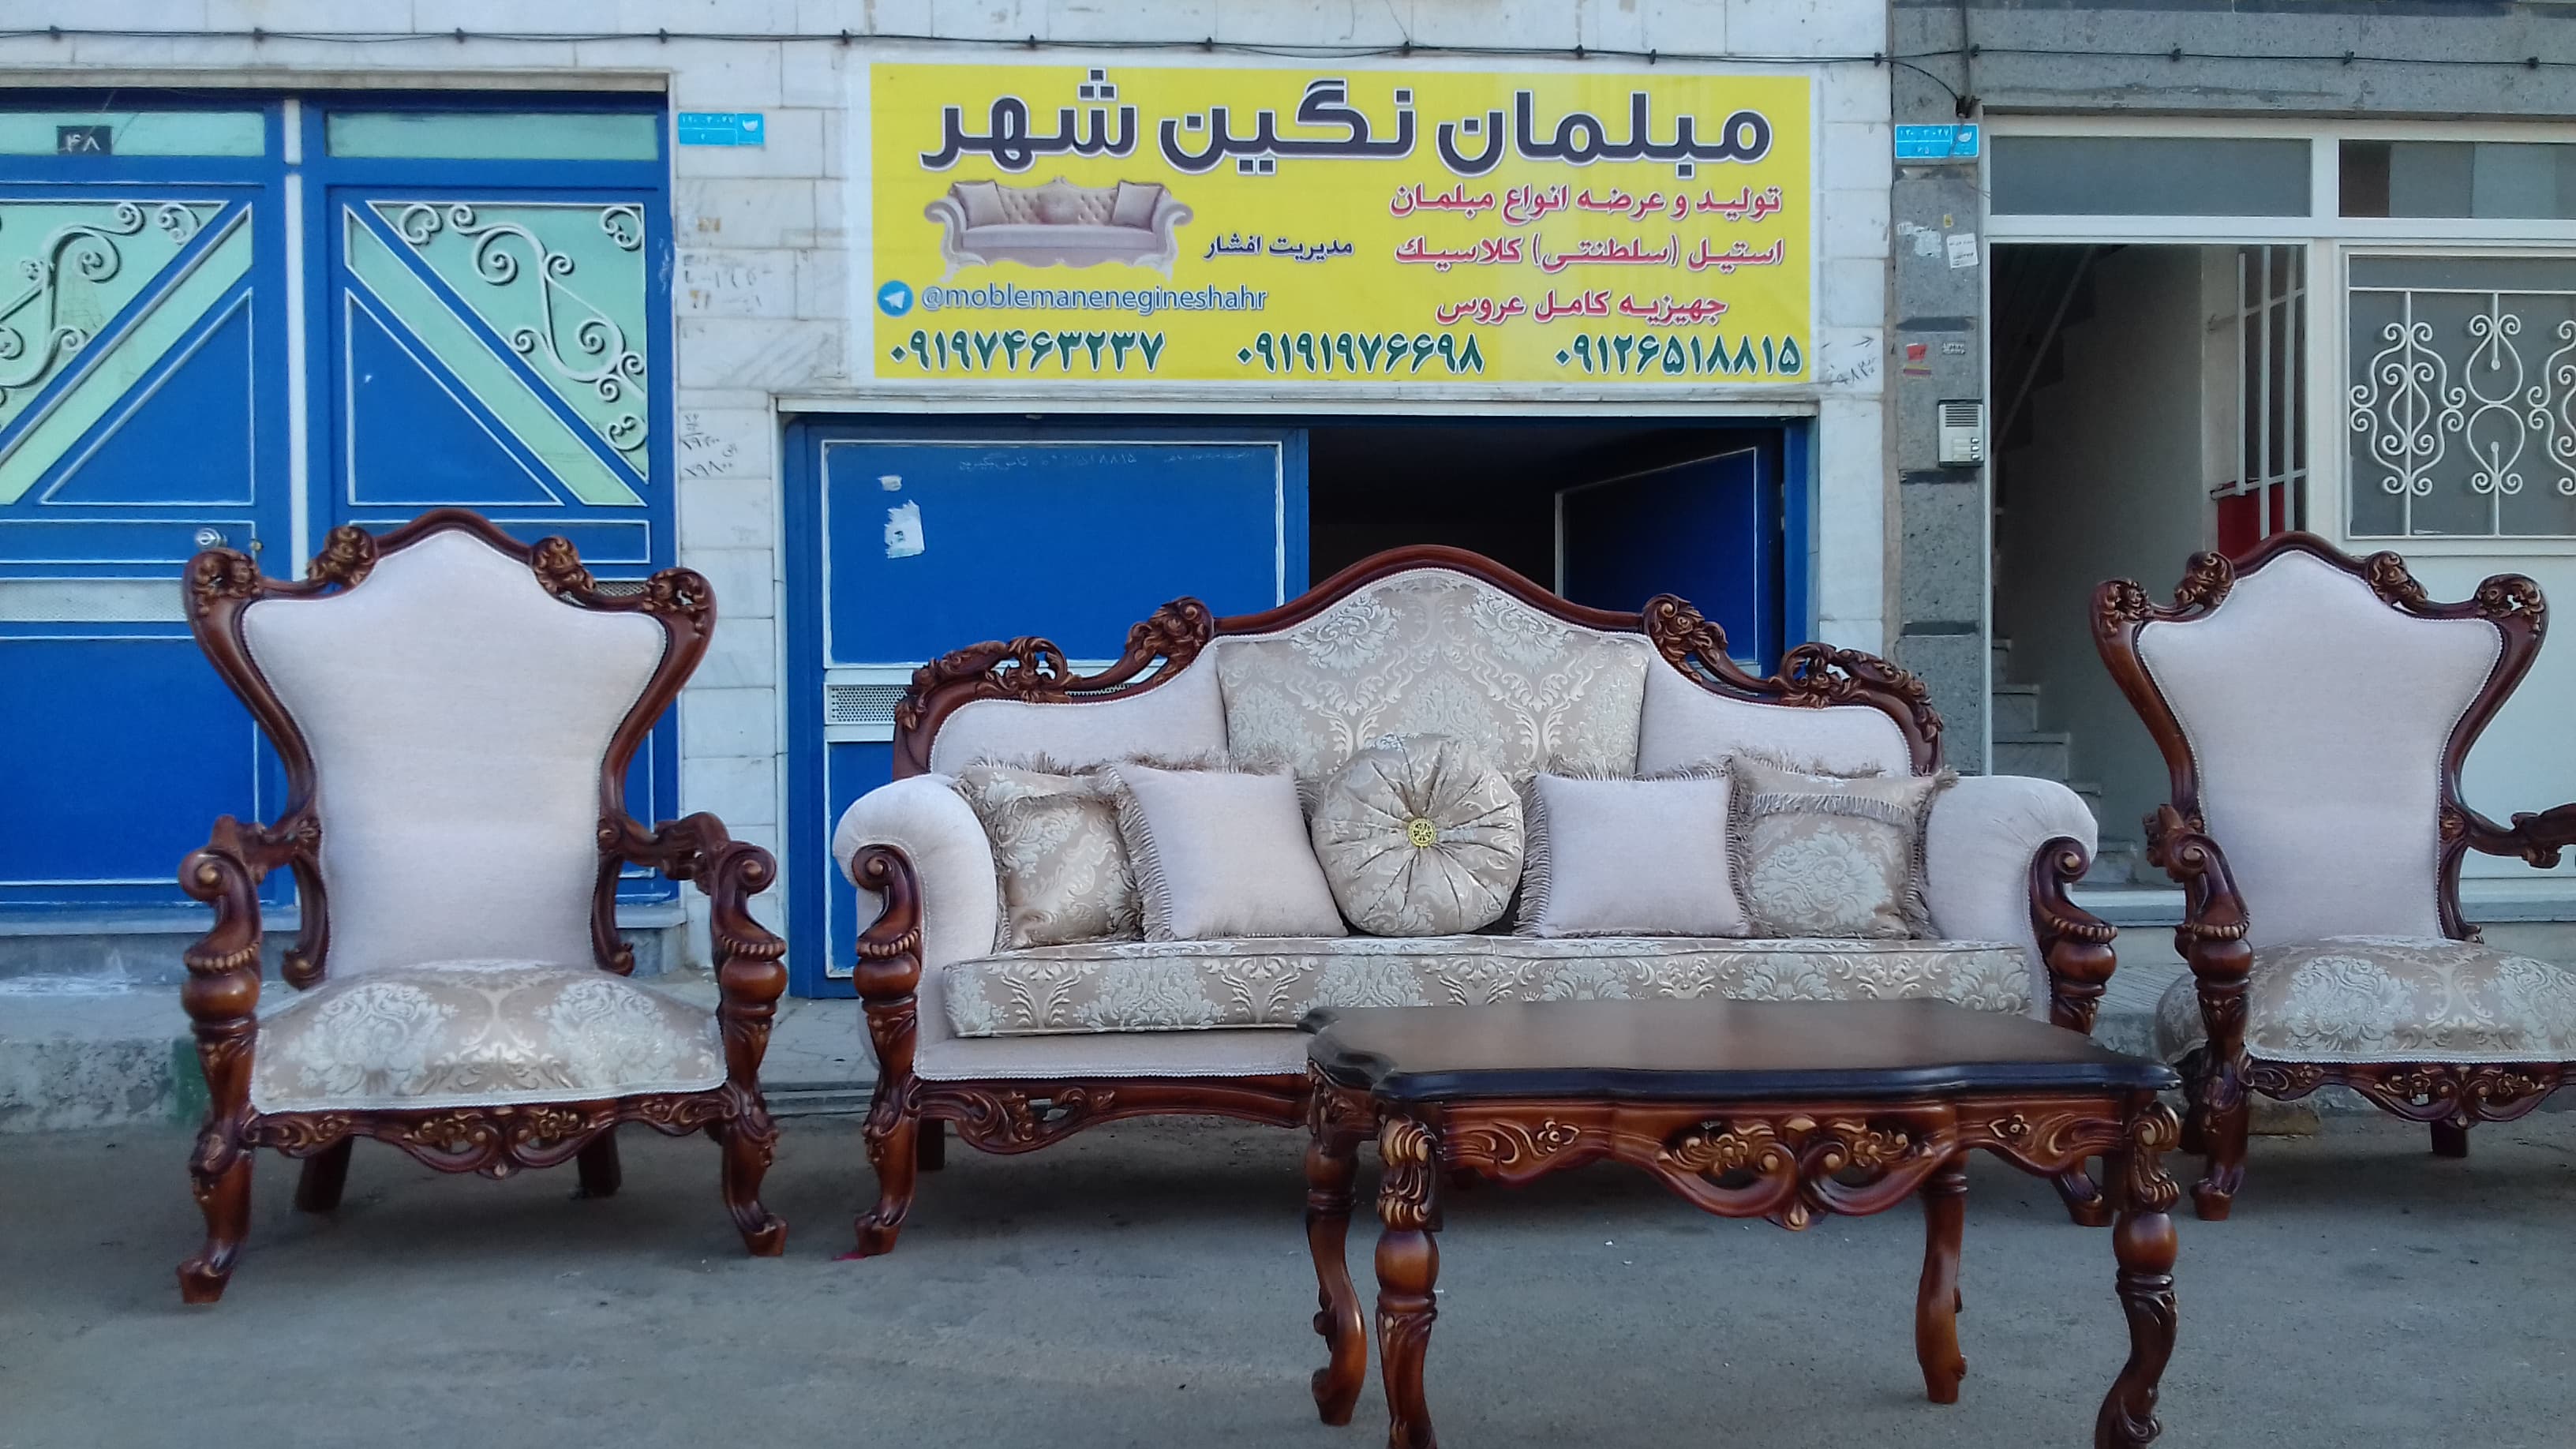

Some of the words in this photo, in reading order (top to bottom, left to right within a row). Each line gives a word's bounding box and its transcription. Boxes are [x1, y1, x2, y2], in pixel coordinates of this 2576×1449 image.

[919, 68, 1138, 174] شهر
[1159, 77, 1416, 175] نگین
[1436, 88, 1773, 178] مبلمان
[66, 133, 101, 152] ۴۸
[1390, 182, 1496, 219] مبلمان
[1501, 183, 1569, 225] انواع
[1576, 187, 1667, 221] عرضه
[1668, 197, 1689, 220] و
[1695, 185, 1783, 221] تولید
[1202, 232, 1263, 261] افشار
[1267, 237, 1354, 263] مدیریت
[1532, 233, 1679, 273] (سلطنتی)
[1687, 238, 1785, 275] استیل
[921, 282, 1268, 316] @moblemanenegineshahr
[1435, 292, 1528, 325] عروس
[1533, 289, 1611, 323] کامل
[1617, 293, 1729, 327] جهیزیه
[889, 328, 1166, 373] ۰۹۱۹۷۴۶۳۲۳۷
[1237, 331, 1485, 375] ۰۹۱۹۱۹۷۶۶۹۸
[1554, 333, 1803, 376] ۰۹۱۲۶۵۱۸۸۱۵
